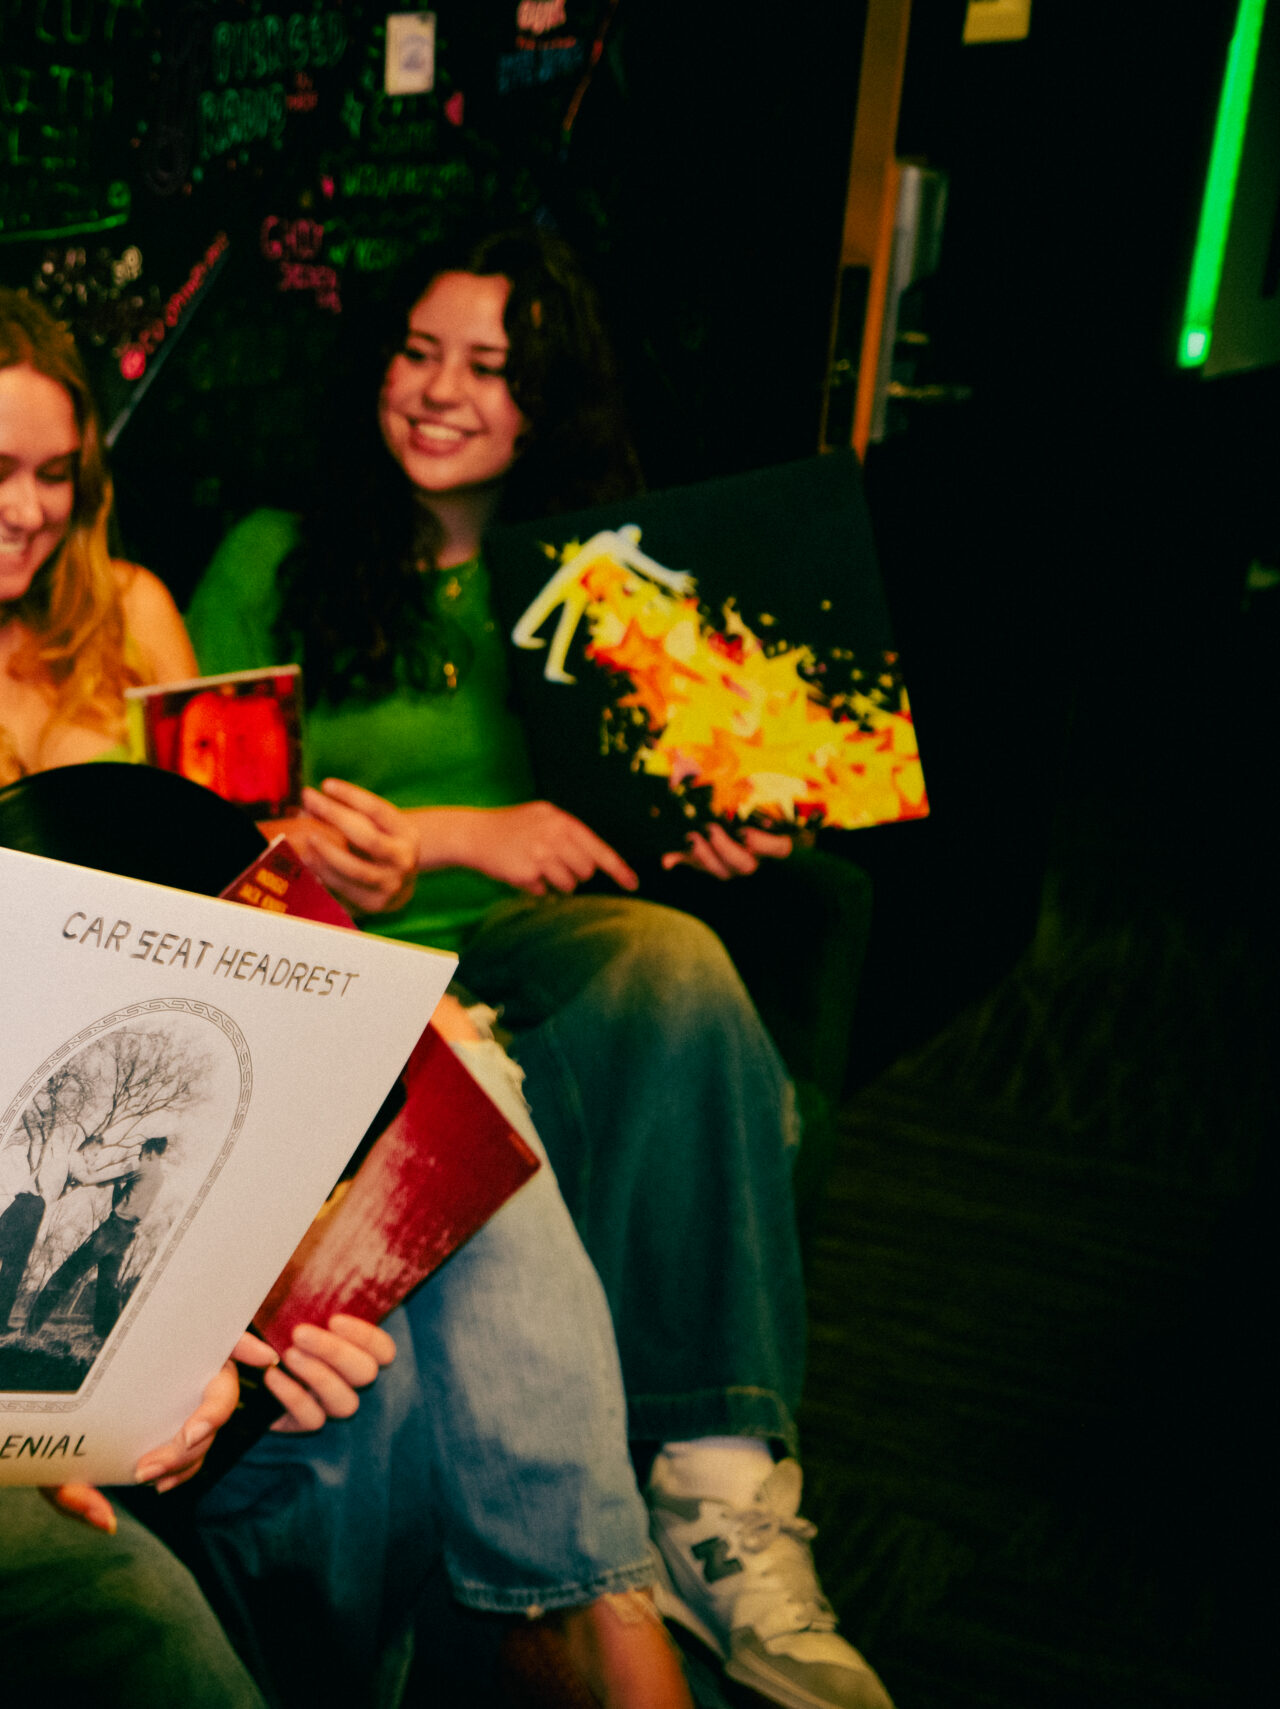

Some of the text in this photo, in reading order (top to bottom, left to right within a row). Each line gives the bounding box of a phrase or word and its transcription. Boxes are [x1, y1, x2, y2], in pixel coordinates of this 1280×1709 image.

[62, 911, 360, 998] CAR SEAT HEADREST
